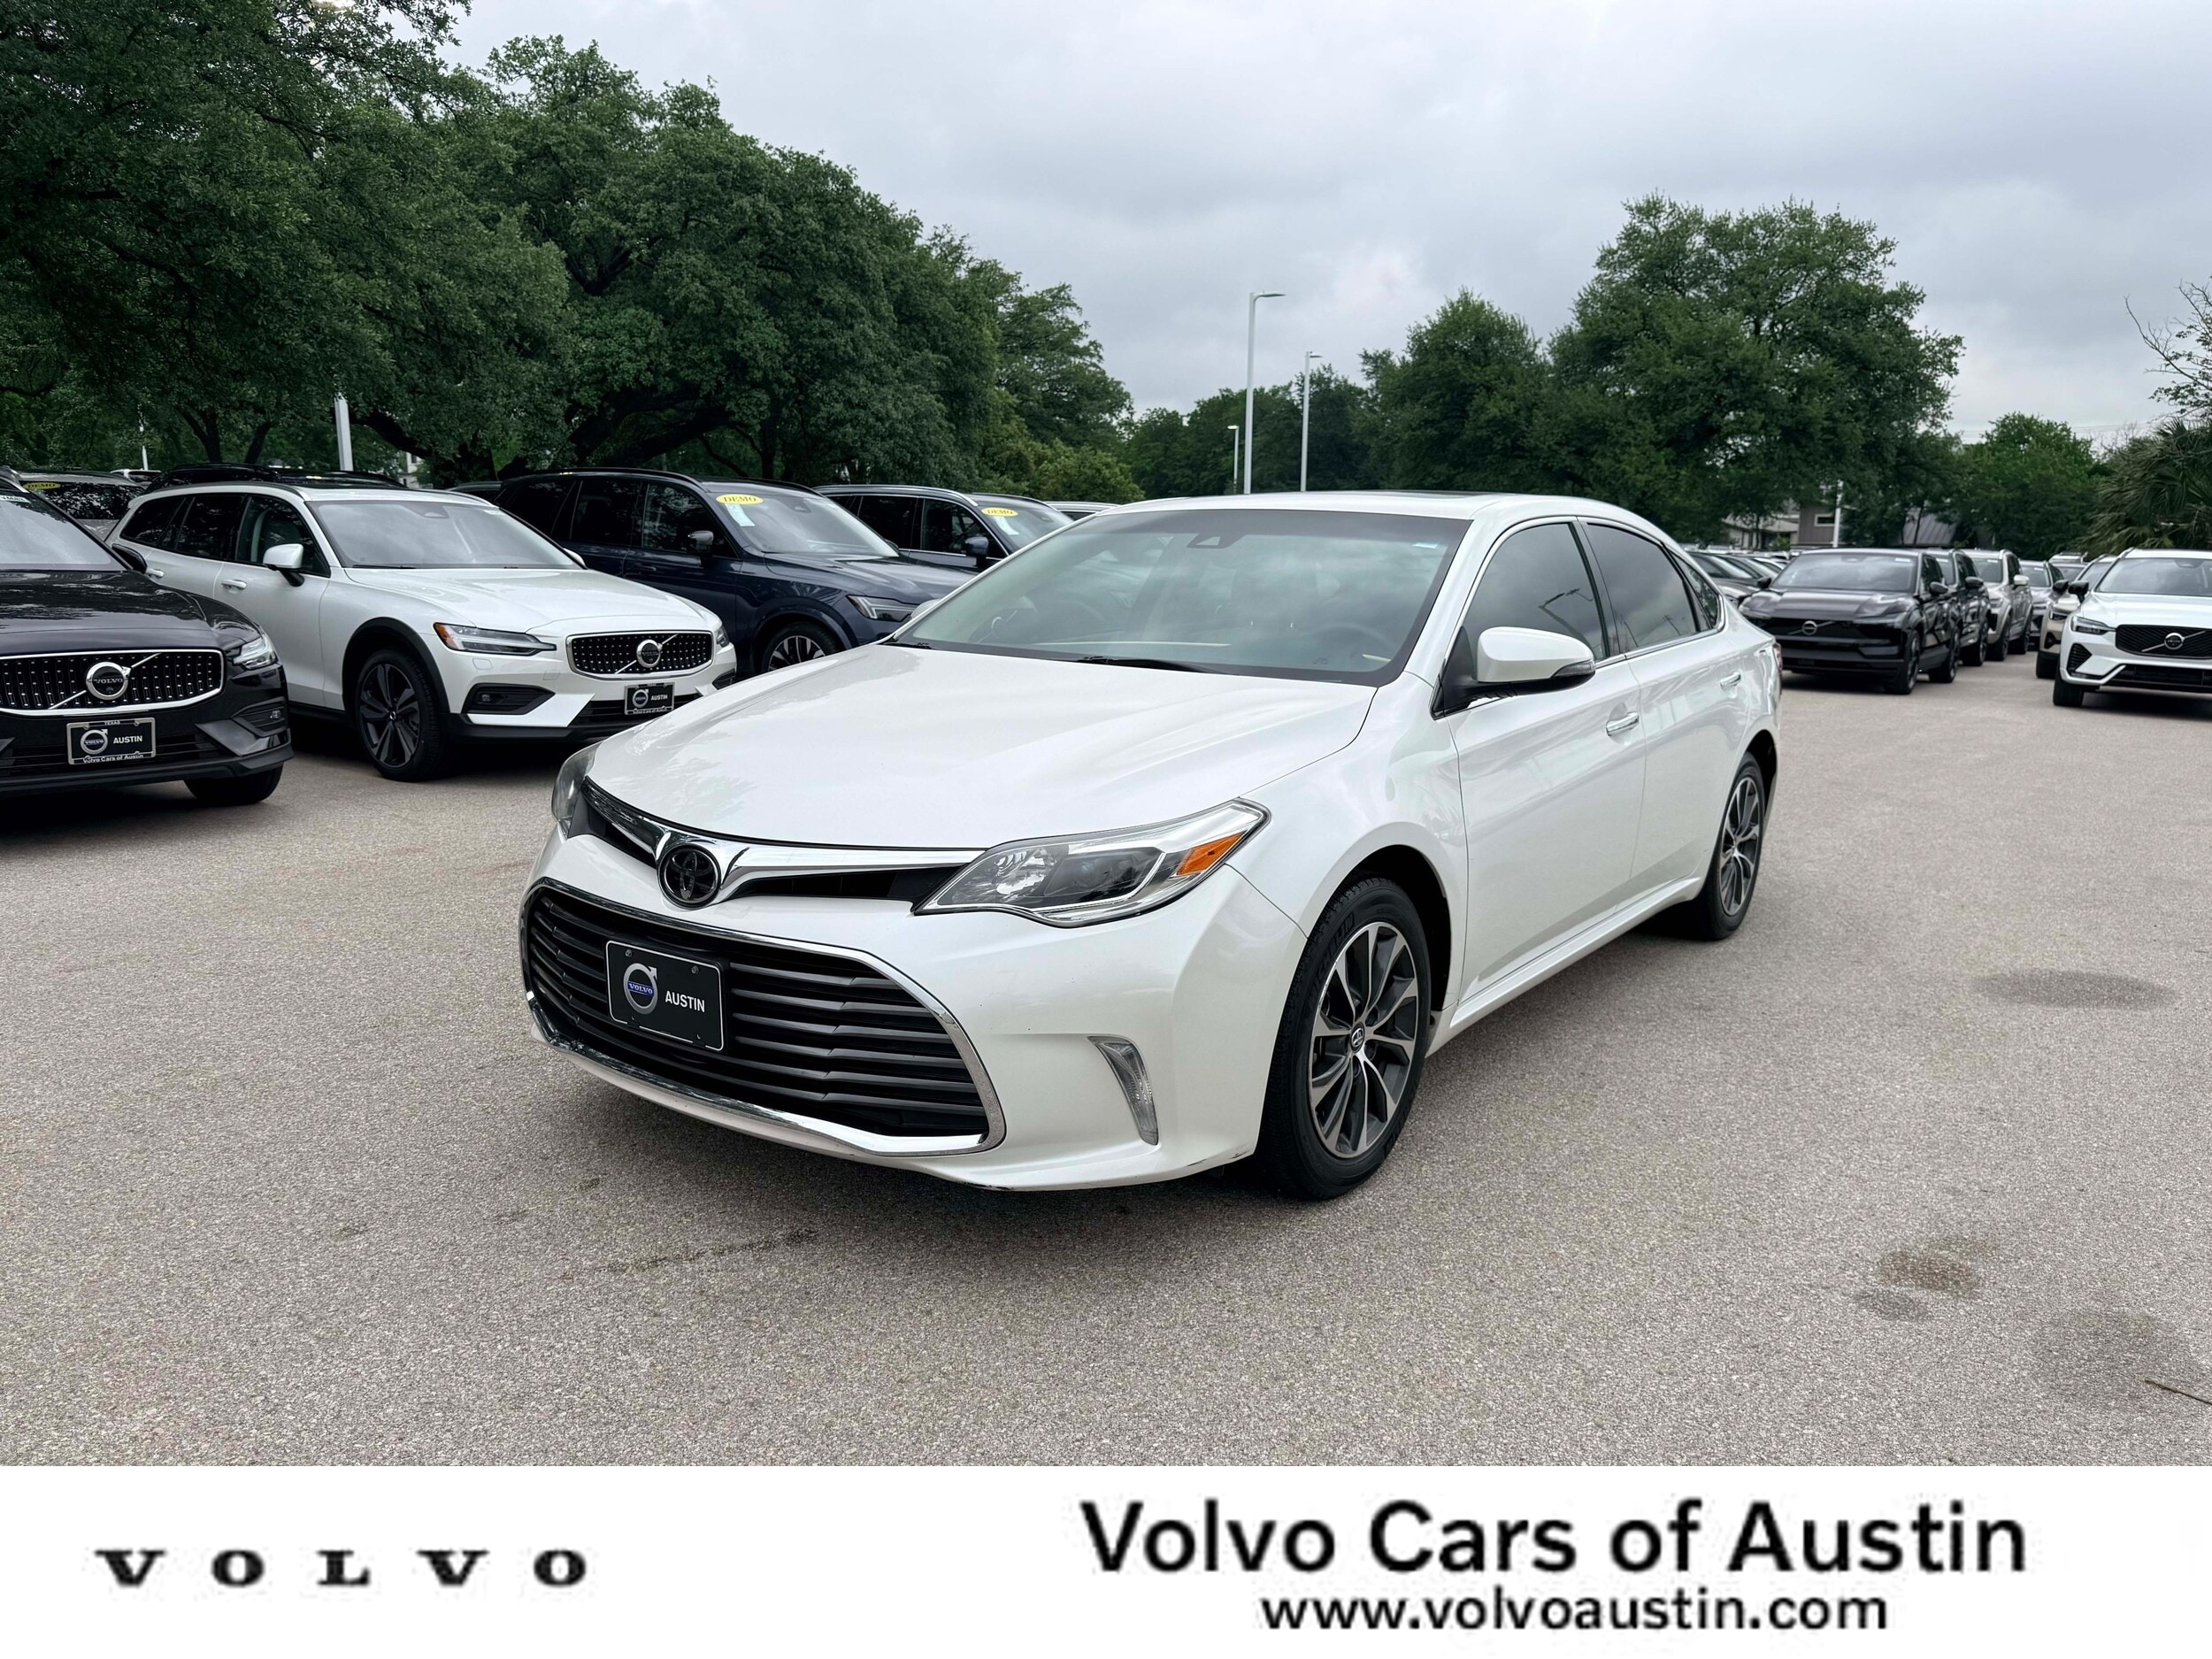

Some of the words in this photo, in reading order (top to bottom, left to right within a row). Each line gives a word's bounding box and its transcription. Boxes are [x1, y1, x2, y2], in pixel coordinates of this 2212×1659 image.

[112, 735, 142, 744] AUSTIN
[629, 983, 653, 995] VOLVO
[664, 990, 705, 1013] AUSTIN
